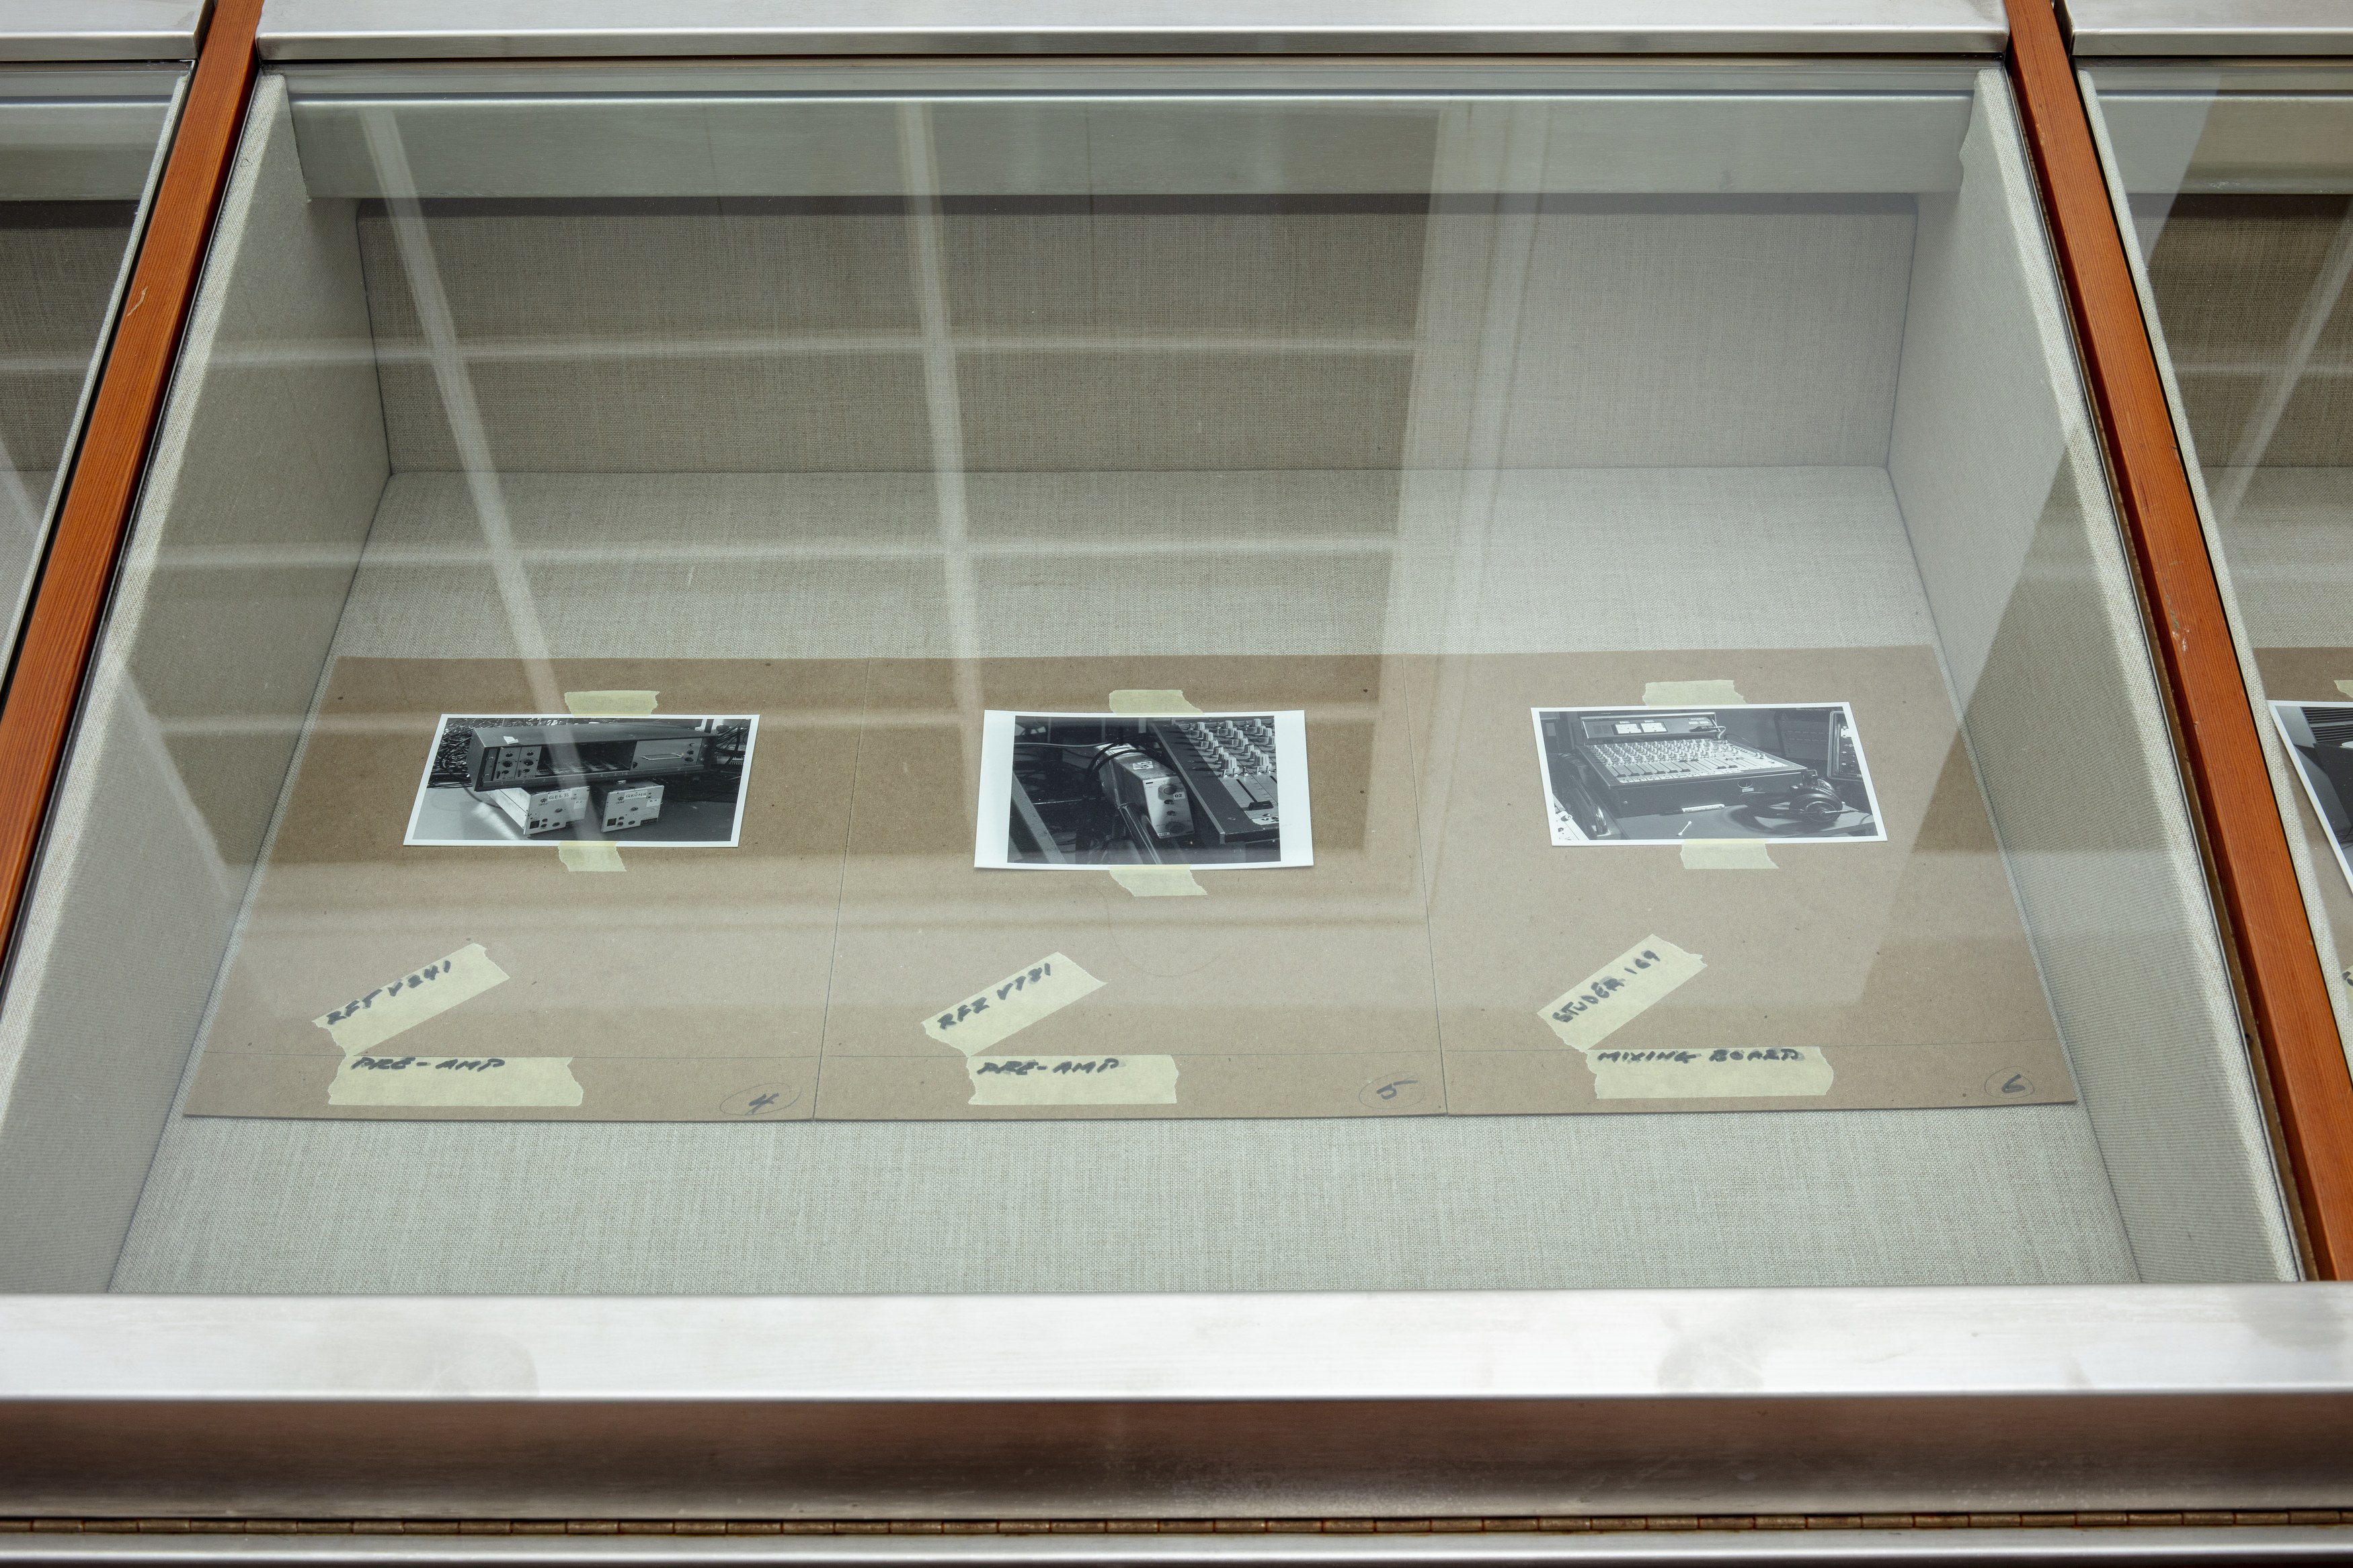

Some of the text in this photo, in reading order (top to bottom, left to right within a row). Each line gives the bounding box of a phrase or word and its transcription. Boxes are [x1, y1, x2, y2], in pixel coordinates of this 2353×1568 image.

[1552, 976, 1625, 1023] STUDER
[1597, 1048, 1804, 1064] MIXING BOARD
[1375, 1079, 1419, 1100] 5
[2001, 1073, 2026, 1094] 6
[748, 1092, 780, 1115] 4
